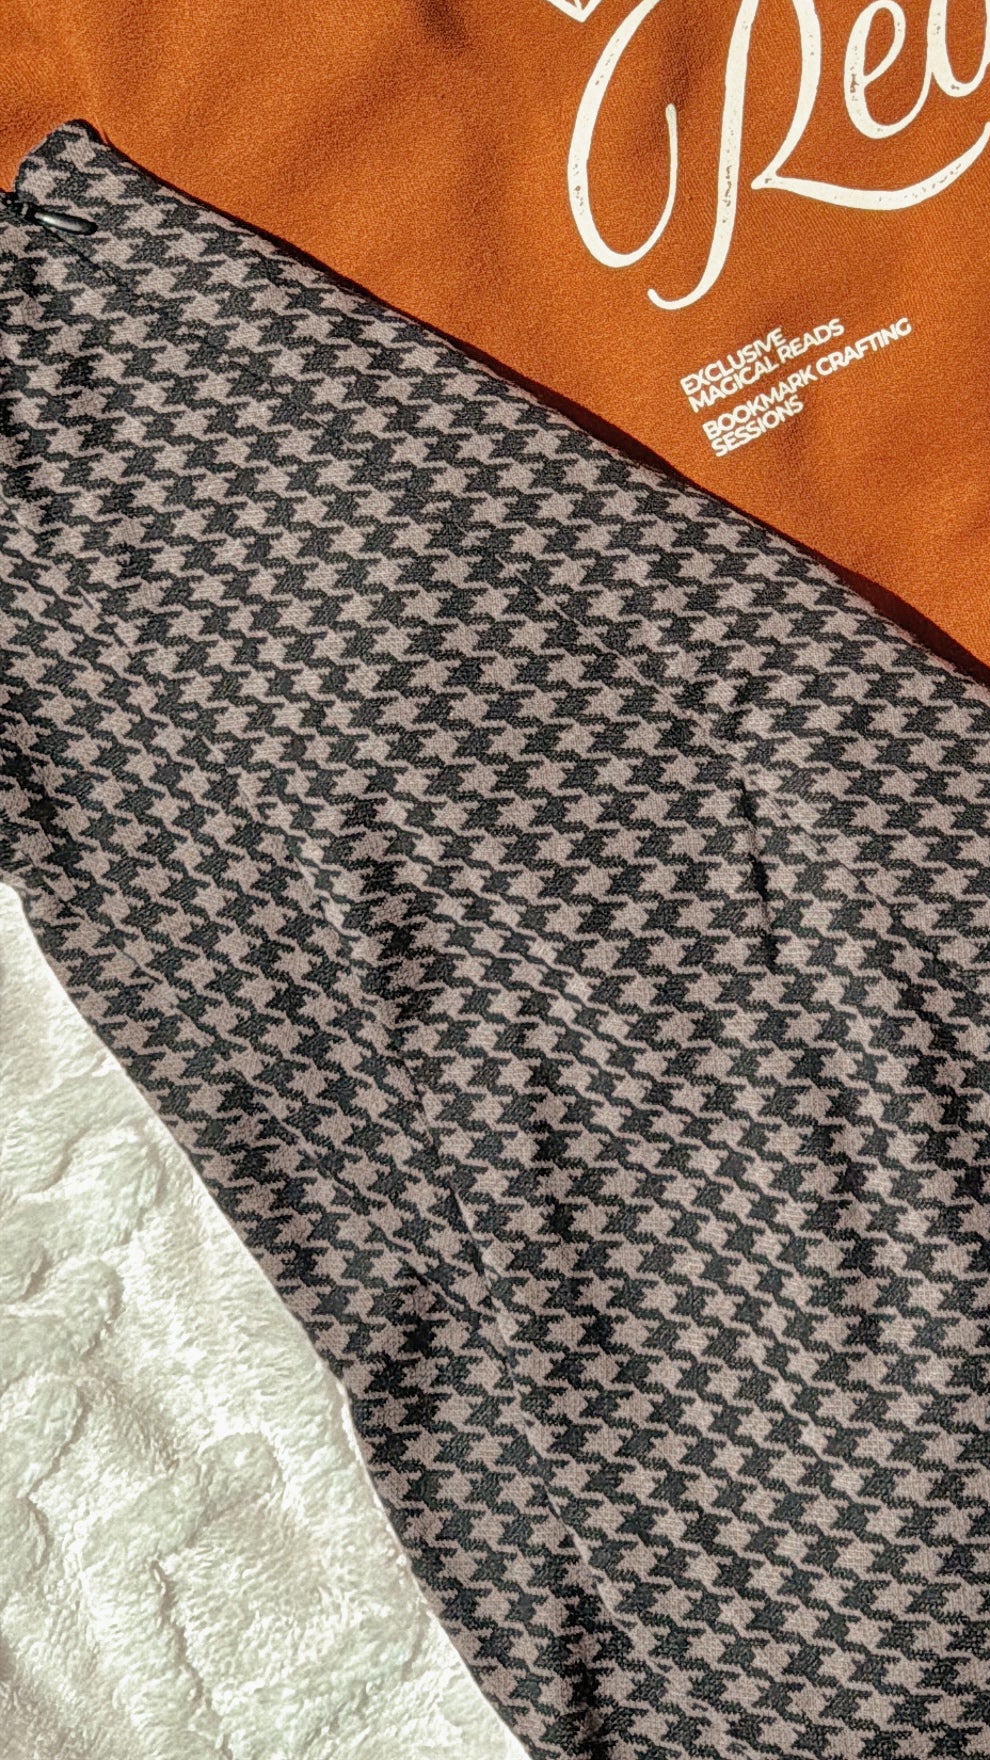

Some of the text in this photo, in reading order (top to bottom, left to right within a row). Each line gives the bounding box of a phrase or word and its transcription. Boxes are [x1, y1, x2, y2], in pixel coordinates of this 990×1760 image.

[679, 327, 787, 396] EXCLUSIVE
[688, 317, 846, 413] MAGICAL READS
[702, 316, 913, 441] BOOKMARK CRAFTING
[710, 394, 805, 458] SESSIONS
